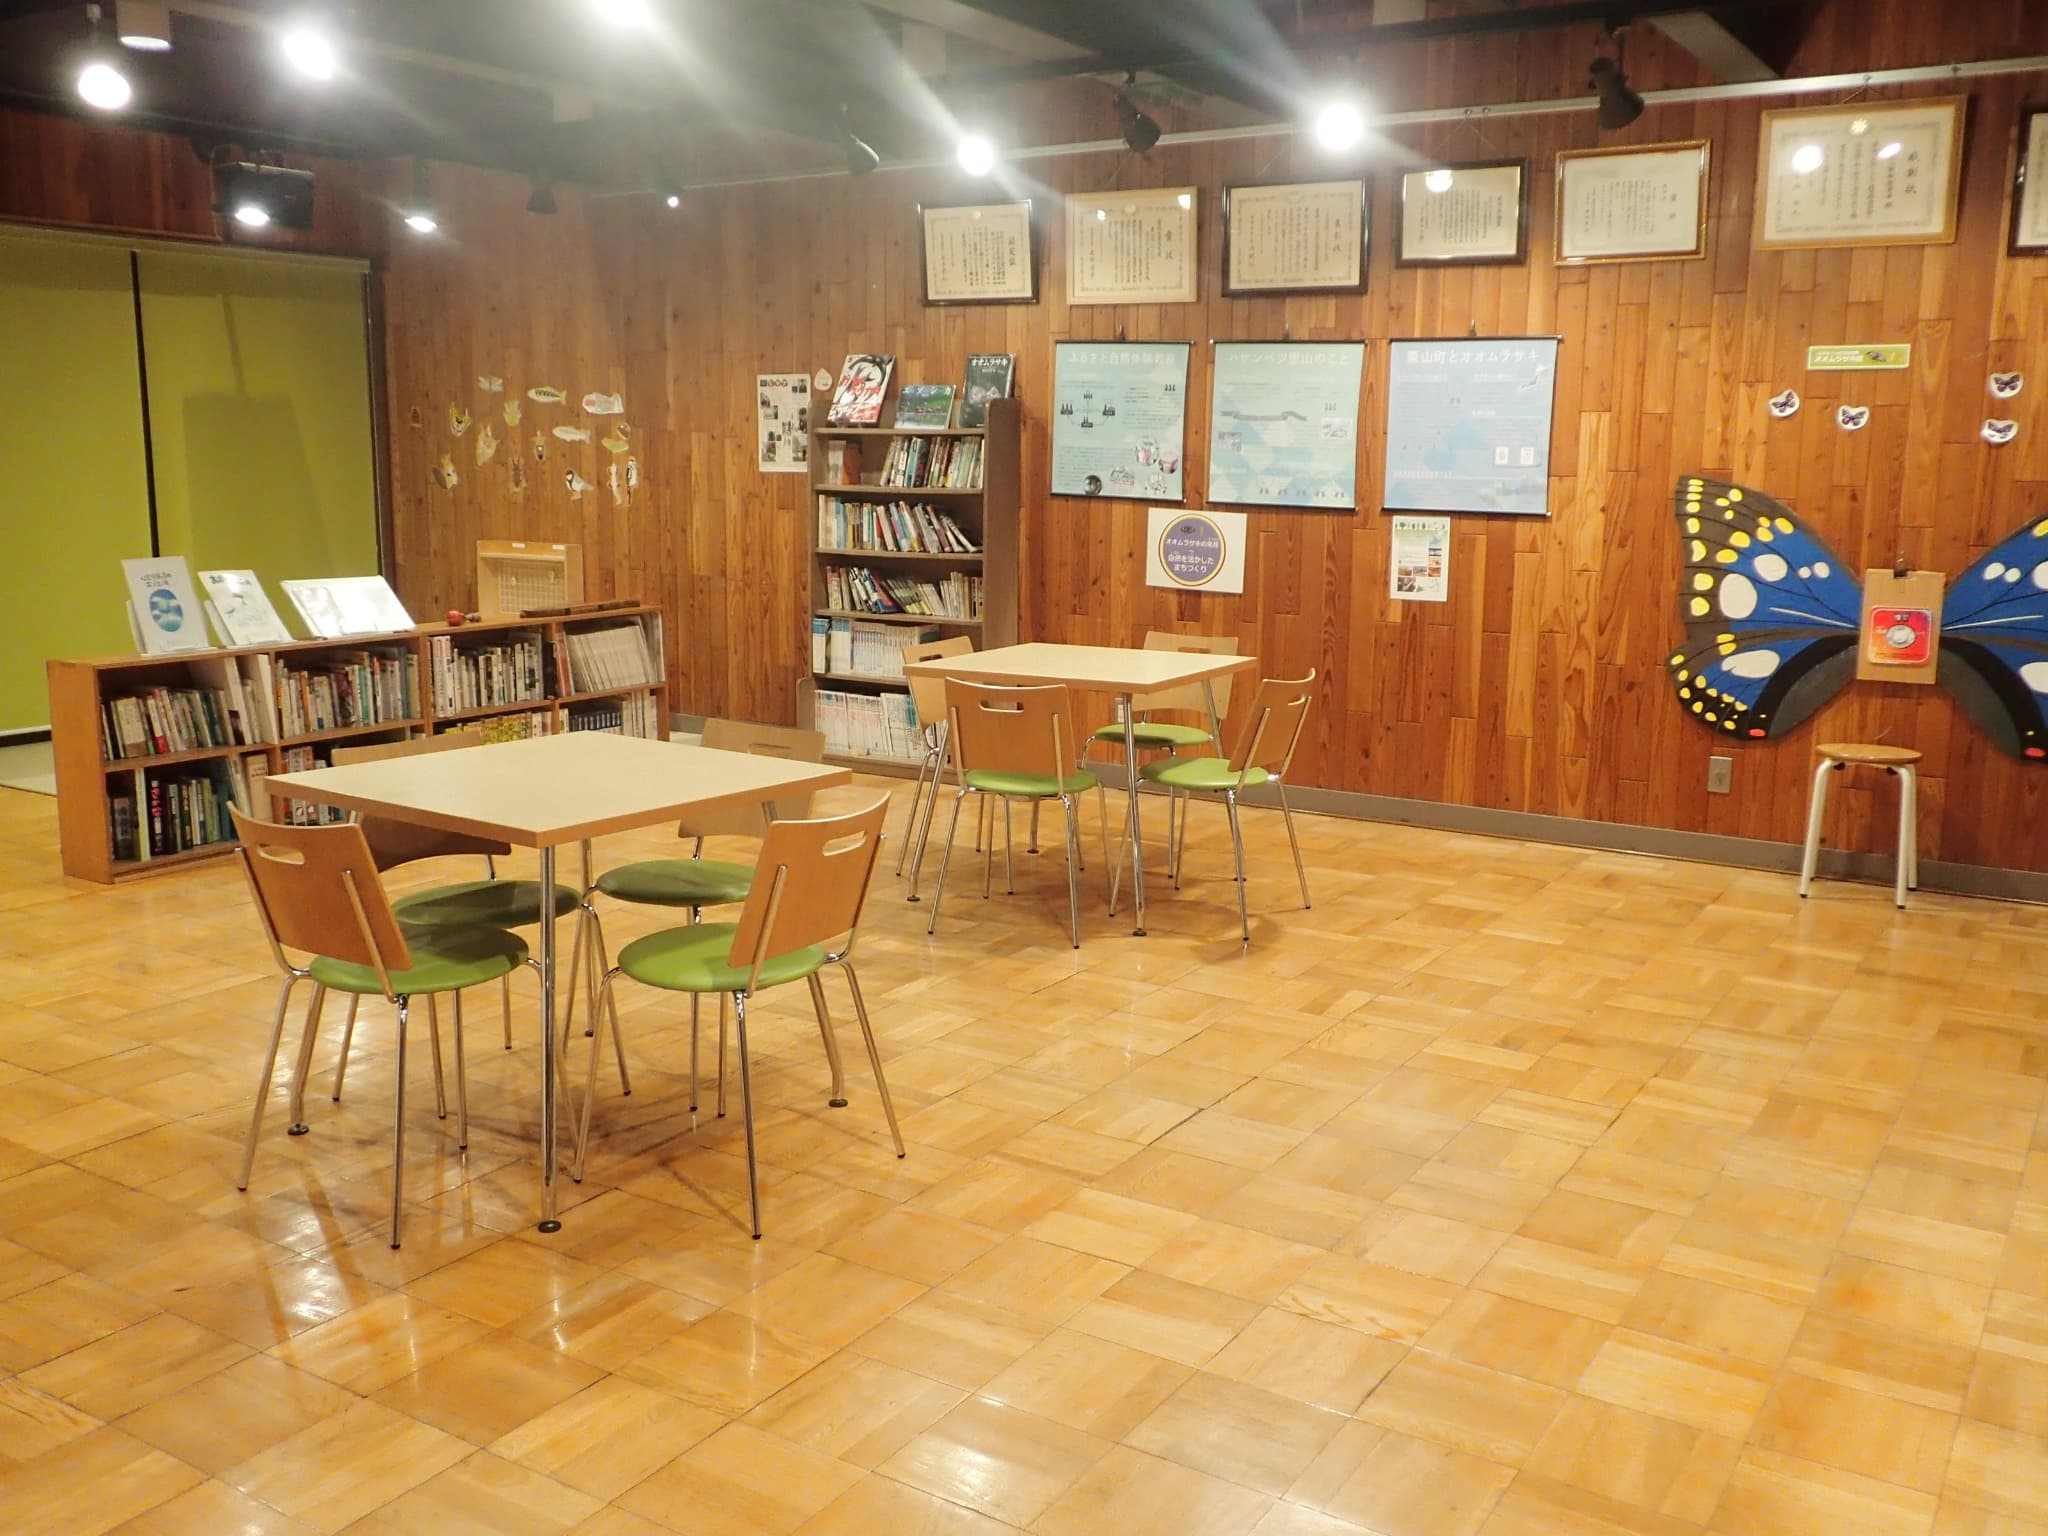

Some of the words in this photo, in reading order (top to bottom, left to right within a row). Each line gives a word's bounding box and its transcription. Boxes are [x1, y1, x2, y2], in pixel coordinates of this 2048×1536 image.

[971, 358, 1009, 367] オオムラサキ
[1174, 564, 1207, 573] まちづくり
